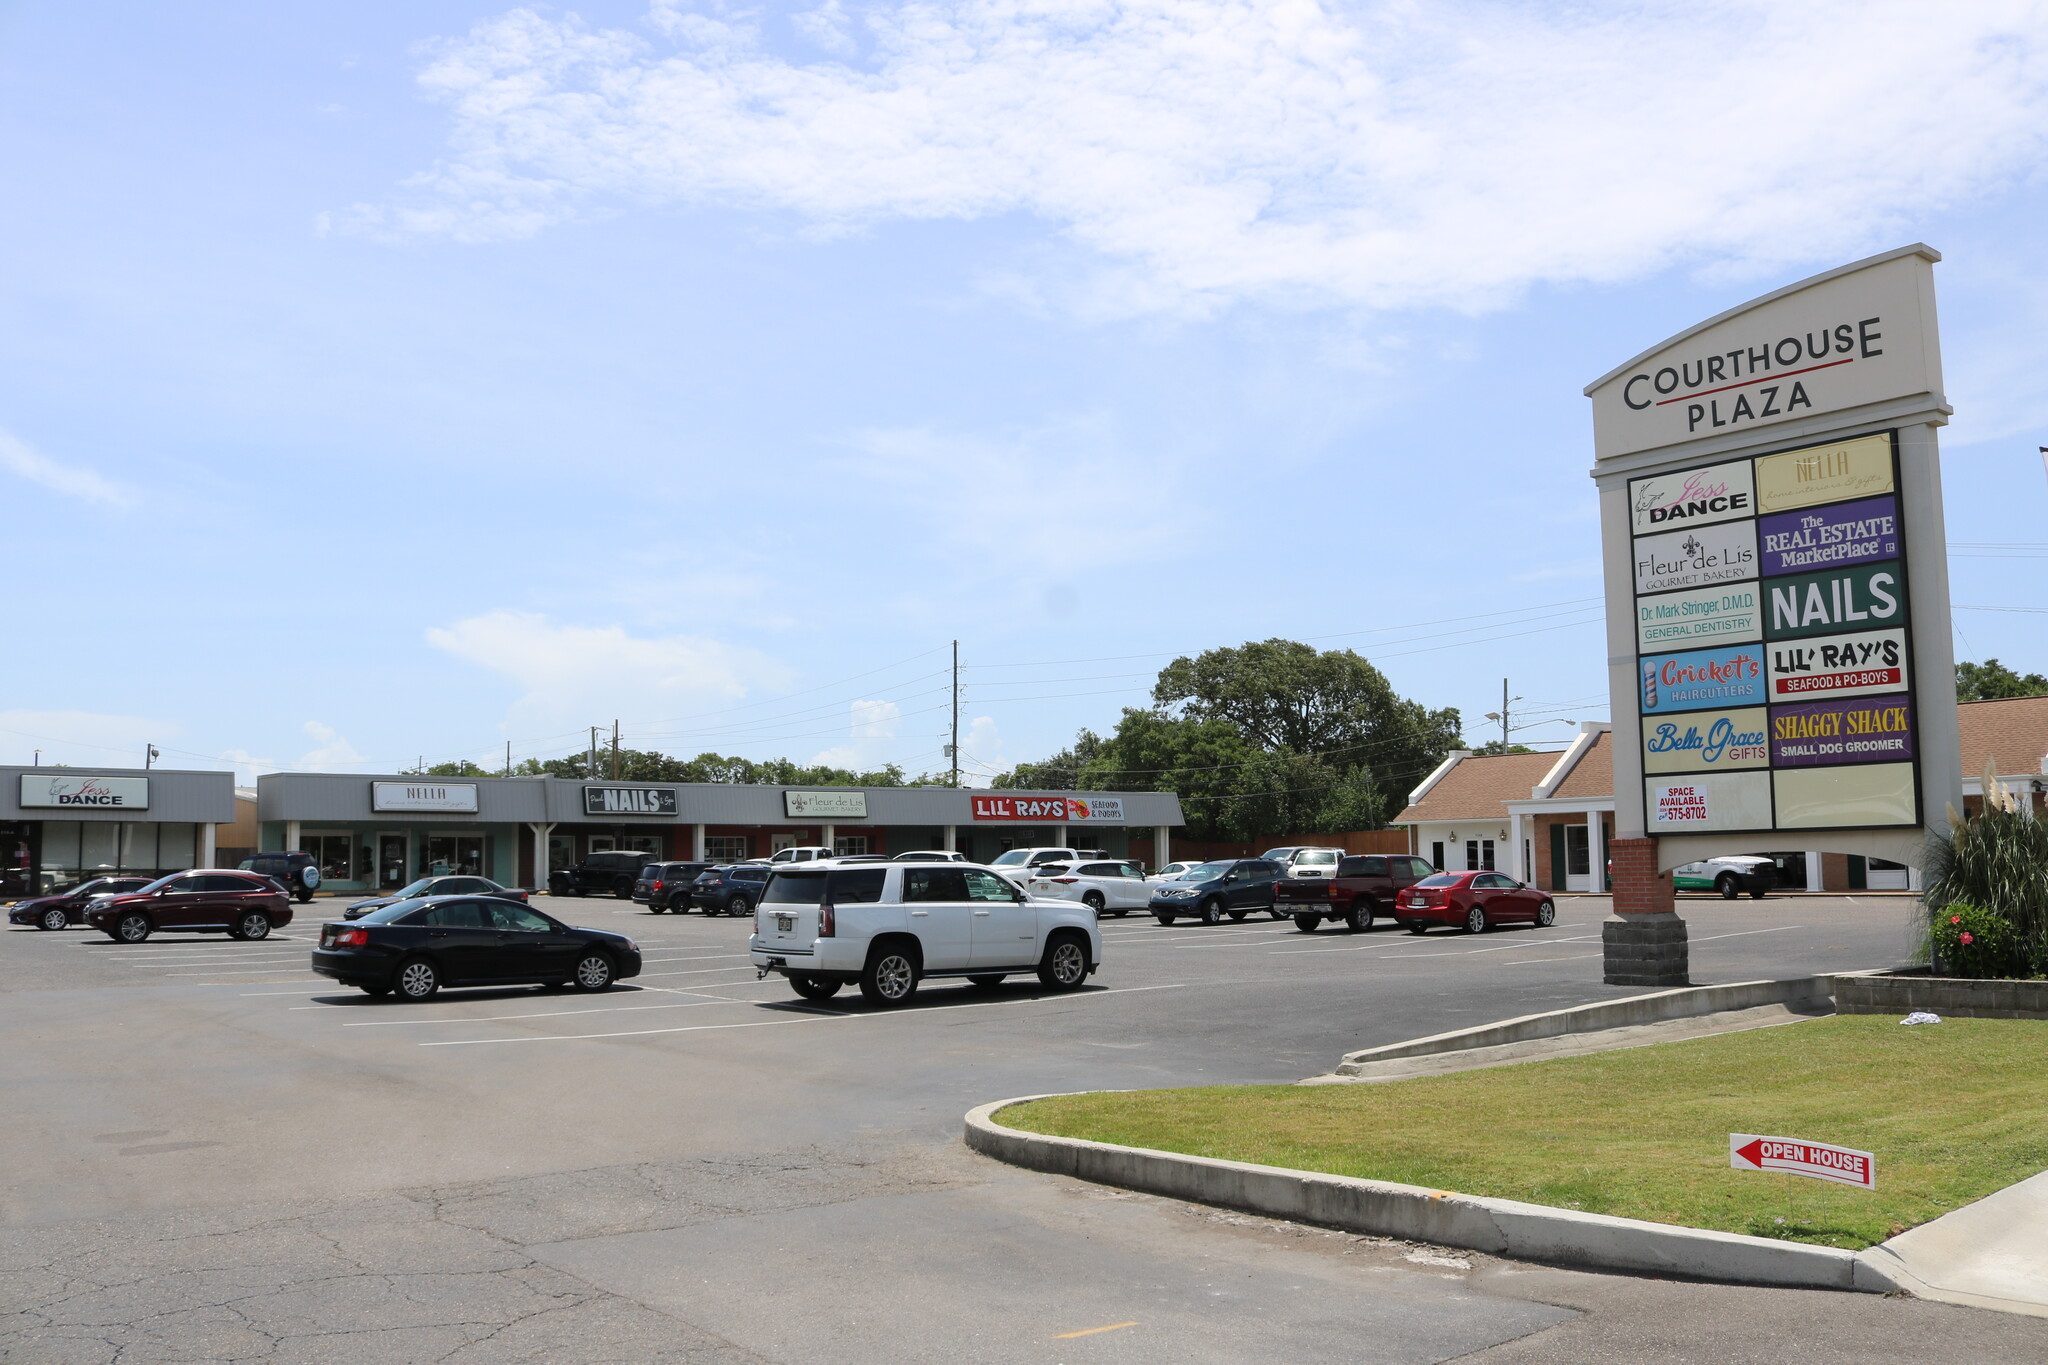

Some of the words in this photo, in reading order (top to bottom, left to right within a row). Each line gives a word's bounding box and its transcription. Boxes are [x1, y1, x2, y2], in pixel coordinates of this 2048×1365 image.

[1624, 317, 1883, 410] COURTHOUSE
[1688, 381, 1812, 433] PLAZA
[1796, 451, 1848, 484] NELLA
[1650, 493, 1748, 523] DANCE
[1801, 516, 1823, 528] The
[1765, 528, 1816, 553] REAL
[1819, 516, 1894, 545] ESTATE
[1639, 554, 1688, 578] Fleur
[1692, 546, 1718, 570] de
[1724, 545, 1753, 566] Lis
[1646, 574, 1698, 590] GOURMET
[1703, 567, 1747, 582] BAKERY
[1641, 607, 1654, 621] Dr.
[1656, 603, 1680, 619] Mark
[1681, 600, 1720, 616] Stringer,
[1722, 593, 1755, 611] D.M.D.
[1772, 573, 1897, 630] NAILS
[1645, 626, 1692, 639] GENERAL
[1694, 617, 1752, 634] DENTISTRY
[1774, 648, 1815, 673] LIL'
[1820, 639, 1899, 669] RAY'S
[1661, 655, 1759, 686] Cricket's
[1787, 675, 1833, 691] SEAFOOD
[1834, 677, 1842, 687] &
[1843, 671, 1889, 686] PO-BOYS
[1672, 684, 1753, 702] HAIRCUTTERS
[1775, 712, 1843, 740] SHAGGY
[1846, 707, 1908, 735] SHACK
[1648, 723, 1704, 753] Bella
[1702, 718, 1765, 763] Grace
[1781, 744, 1817, 757] SMALL
[1819, 743, 1843, 754] DOG
[1845, 738, 1904, 752] GROOMER
[1729, 747, 1766, 760] GIFTS
[69, 779, 111, 796] Jess
[407, 787, 446, 799] NELLA
[1668, 787, 1695, 797] SPACE
[59, 795, 122, 805] DANCE
[603, 789, 660, 812] NAILS
[808, 795, 832, 806] Fleur
[835, 795, 847, 807] de
[849, 797, 863, 807] Lis
[976, 799, 1010, 816] LIL'
[1091, 800, 1119, 809] SEAFOOD
[1660, 796, 1705, 807] AVAILABLE
[1091, 810, 1096, 818] &
[1668, 806, 1706, 820] 575-8702
[1760, 1142, 1804, 1161] OPEN
[1810, 1148, 1864, 1172] HOUSE
